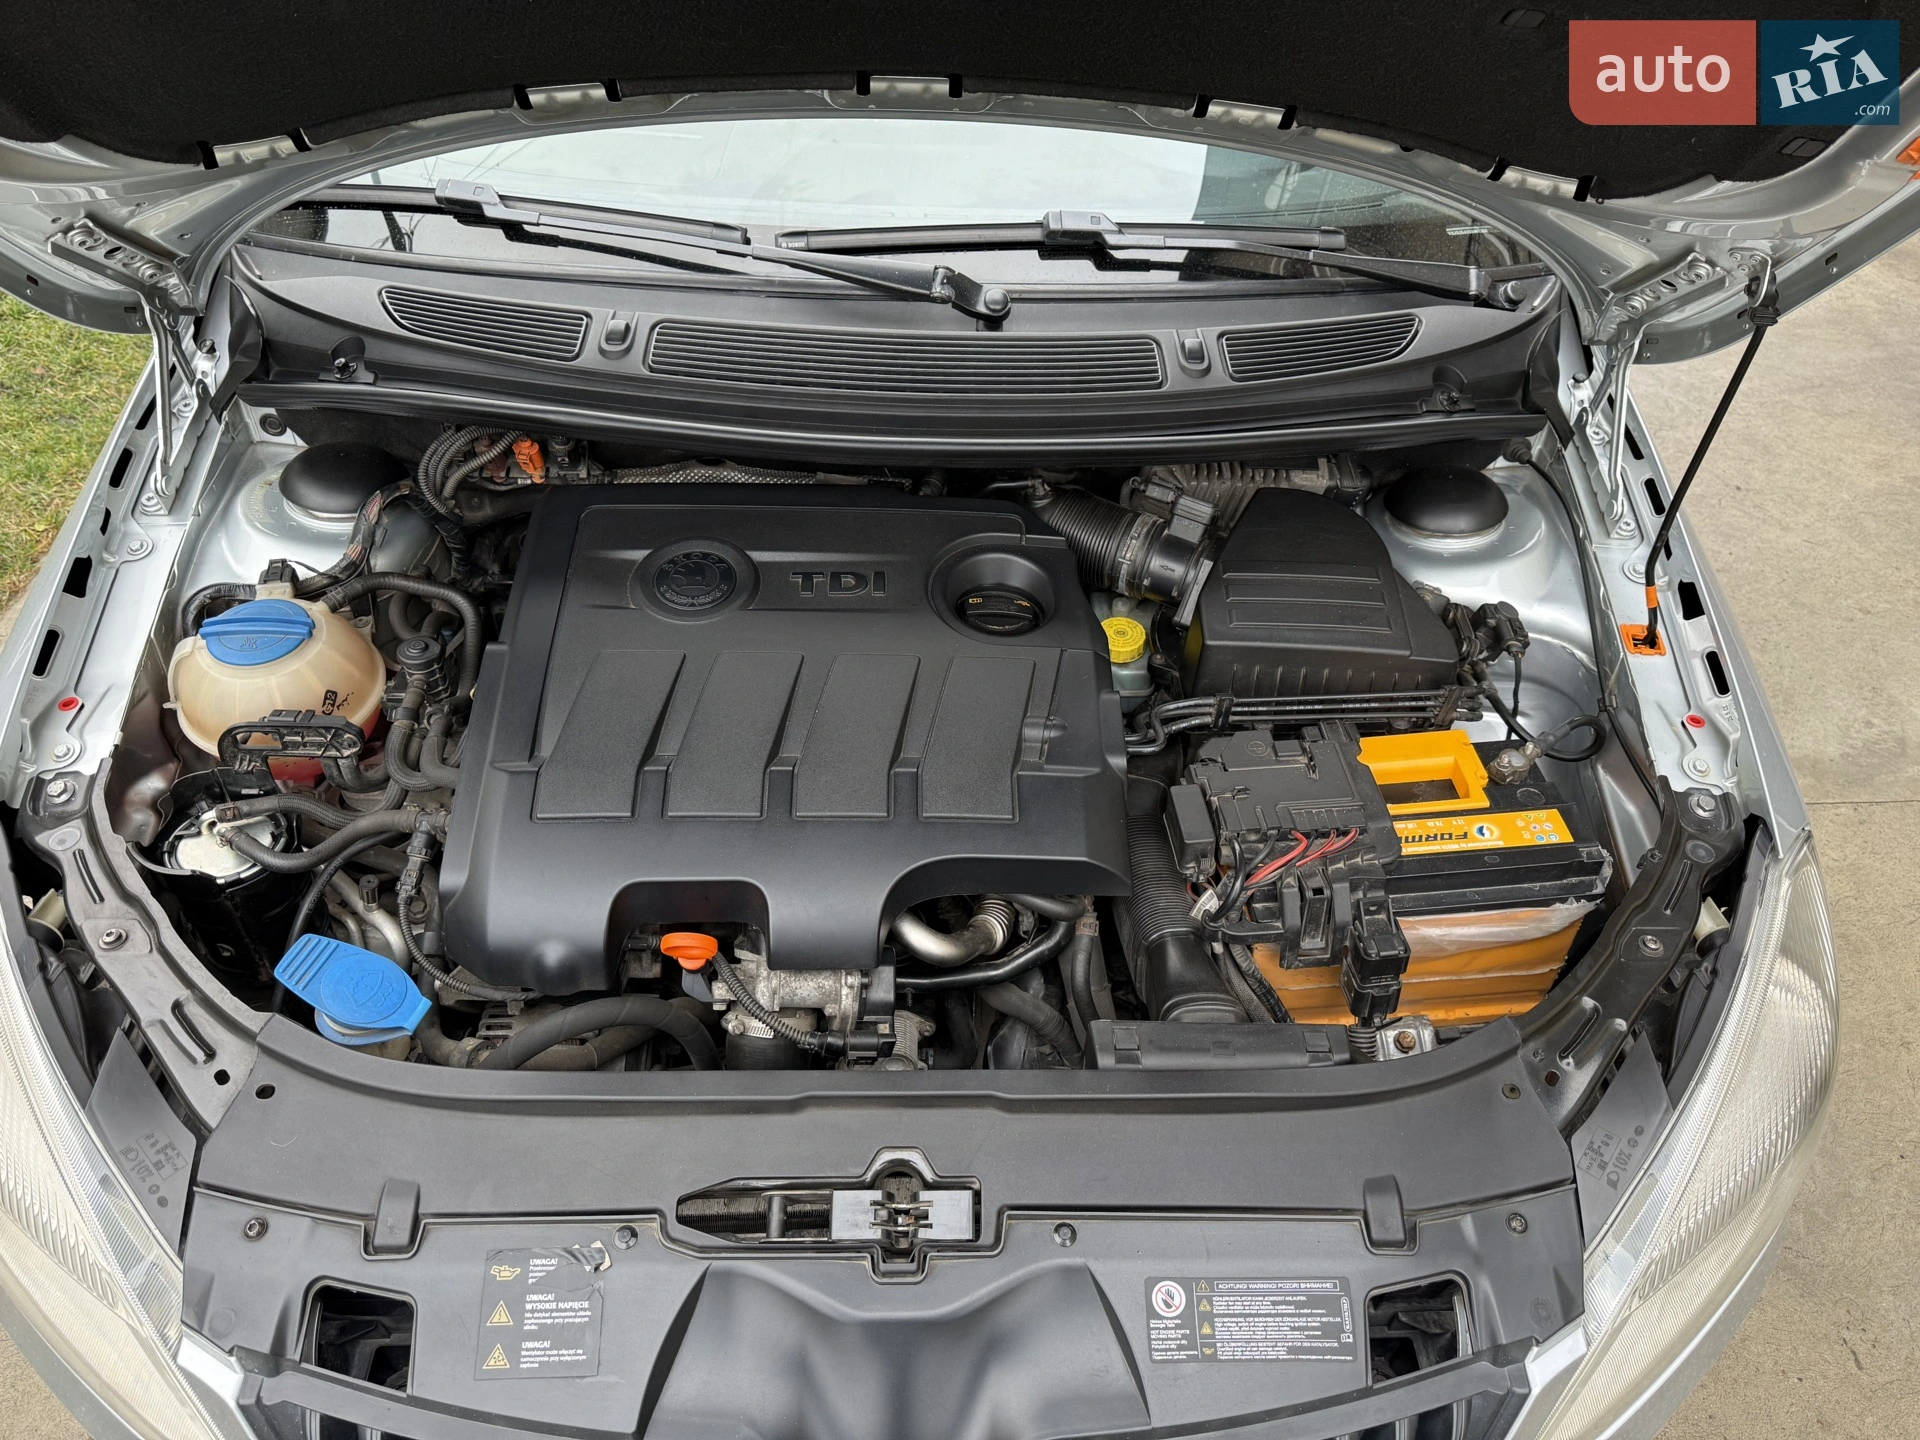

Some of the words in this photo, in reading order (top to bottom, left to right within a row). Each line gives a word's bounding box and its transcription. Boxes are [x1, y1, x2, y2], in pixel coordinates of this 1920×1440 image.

[790, 571, 888, 597] TDI
[1399, 831, 1468, 844] FORM
[526, 1293, 555, 1301] UWAGA!
[525, 1302, 557, 1310] WYSOKIE
[558, 1301, 590, 1309] NAPIĘCIE
[521, 1340, 551, 1349] UWAGA!
